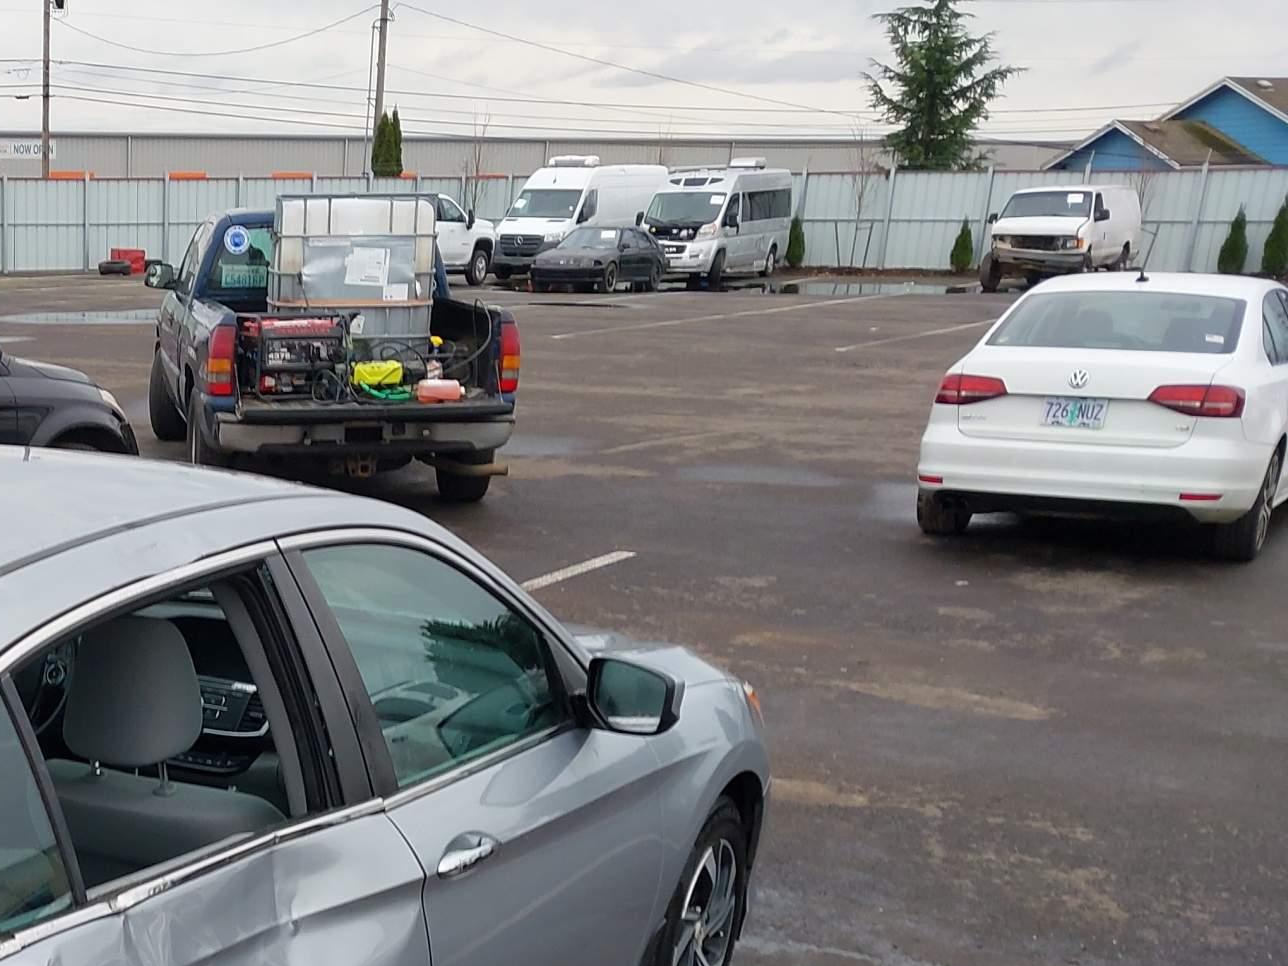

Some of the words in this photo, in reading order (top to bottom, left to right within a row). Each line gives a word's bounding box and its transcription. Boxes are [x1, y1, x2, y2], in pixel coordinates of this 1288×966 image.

[13, 143, 32, 155] NOW
[1046, 401, 1070, 419] 726
[1077, 402, 1103, 421] NUZ
